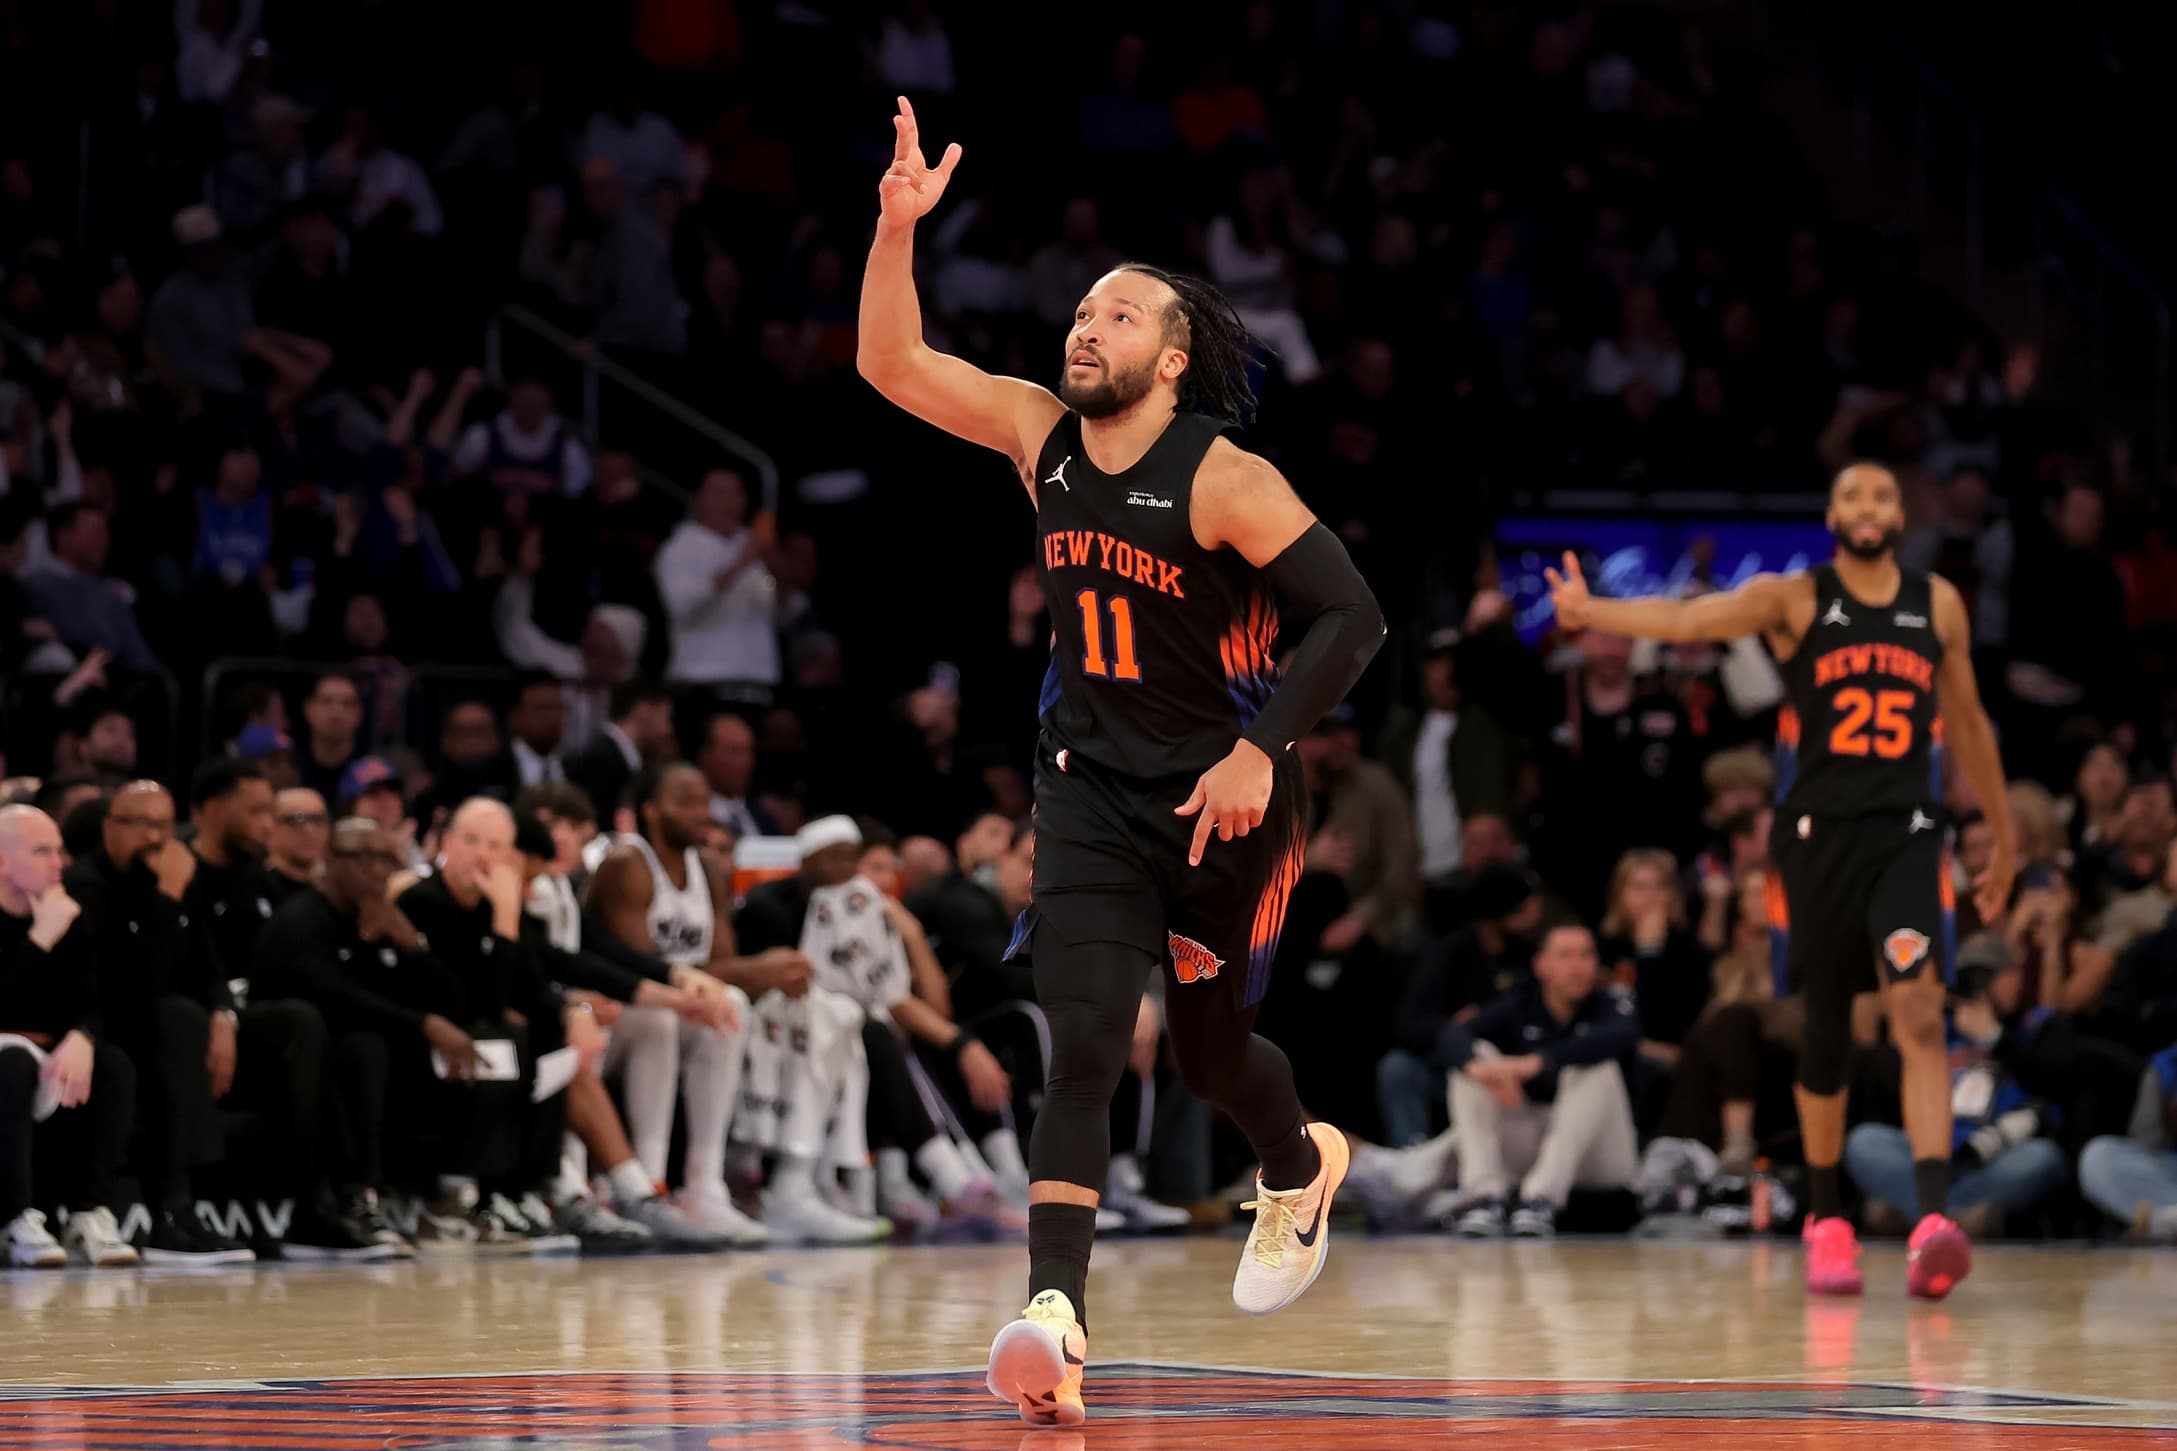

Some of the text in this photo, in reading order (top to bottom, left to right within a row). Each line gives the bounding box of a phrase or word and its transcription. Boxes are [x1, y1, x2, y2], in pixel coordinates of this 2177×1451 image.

[1127, 496, 1173, 508] abu dhabi
[1044, 530, 1185, 598] NEW YORK
[1076, 587, 1142, 684] 11
[1828, 687, 1915, 760] 25
